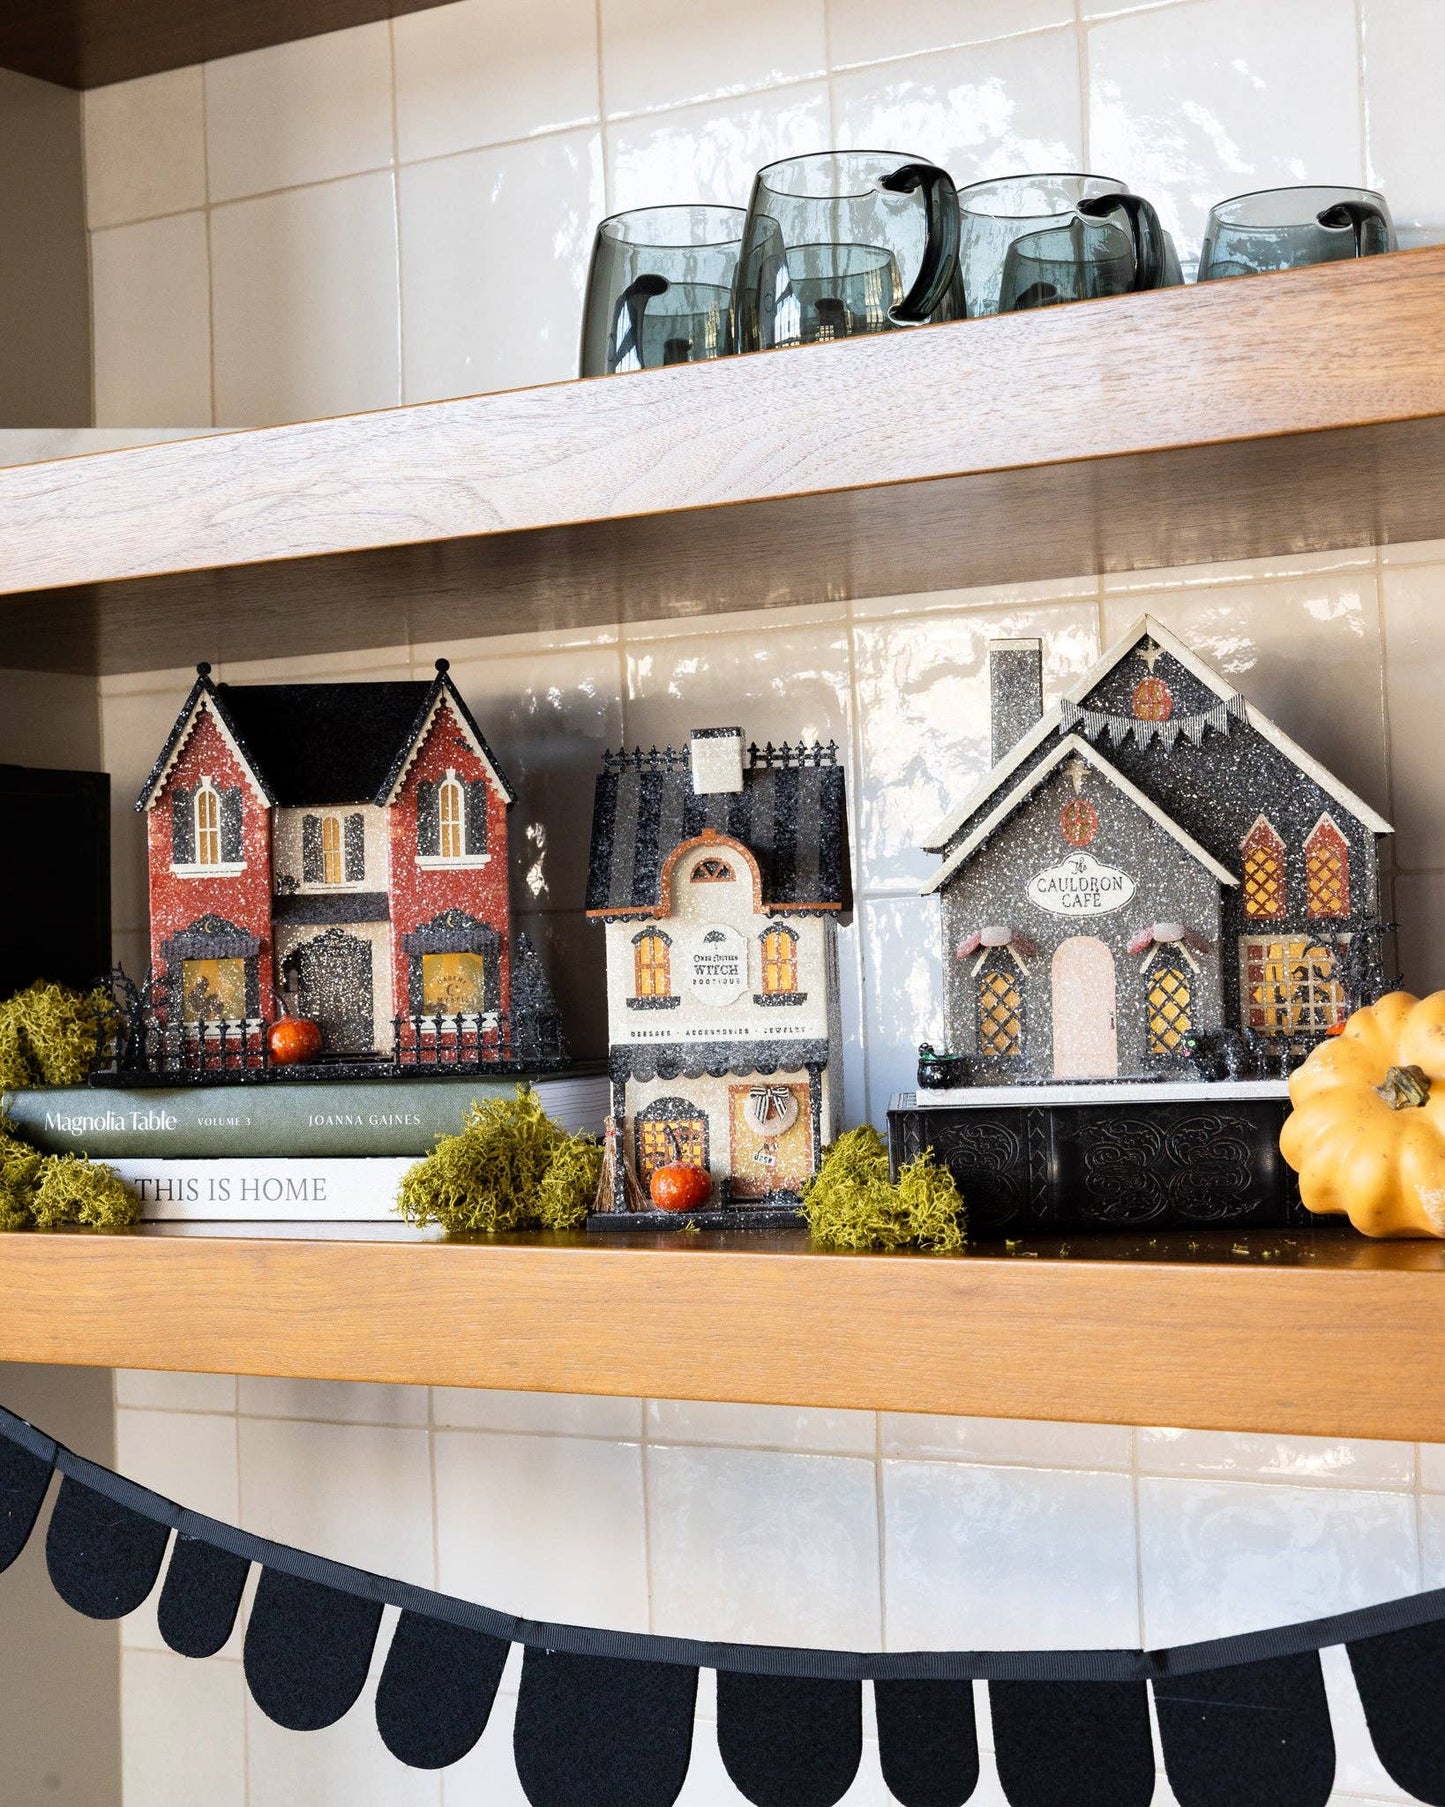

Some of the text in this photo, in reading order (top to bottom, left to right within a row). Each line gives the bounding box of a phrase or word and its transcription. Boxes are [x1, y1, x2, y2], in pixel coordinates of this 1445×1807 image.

[1068, 856, 1088, 875] The
[1036, 876, 1123, 893] CAULDRON
[693, 964, 740, 976] WITCH
[45, 1110, 421, 1136] Magnolia Table VOLUME 3 JOANNA GAINES
[134, 1177, 327, 1201] THIS IS HOME
